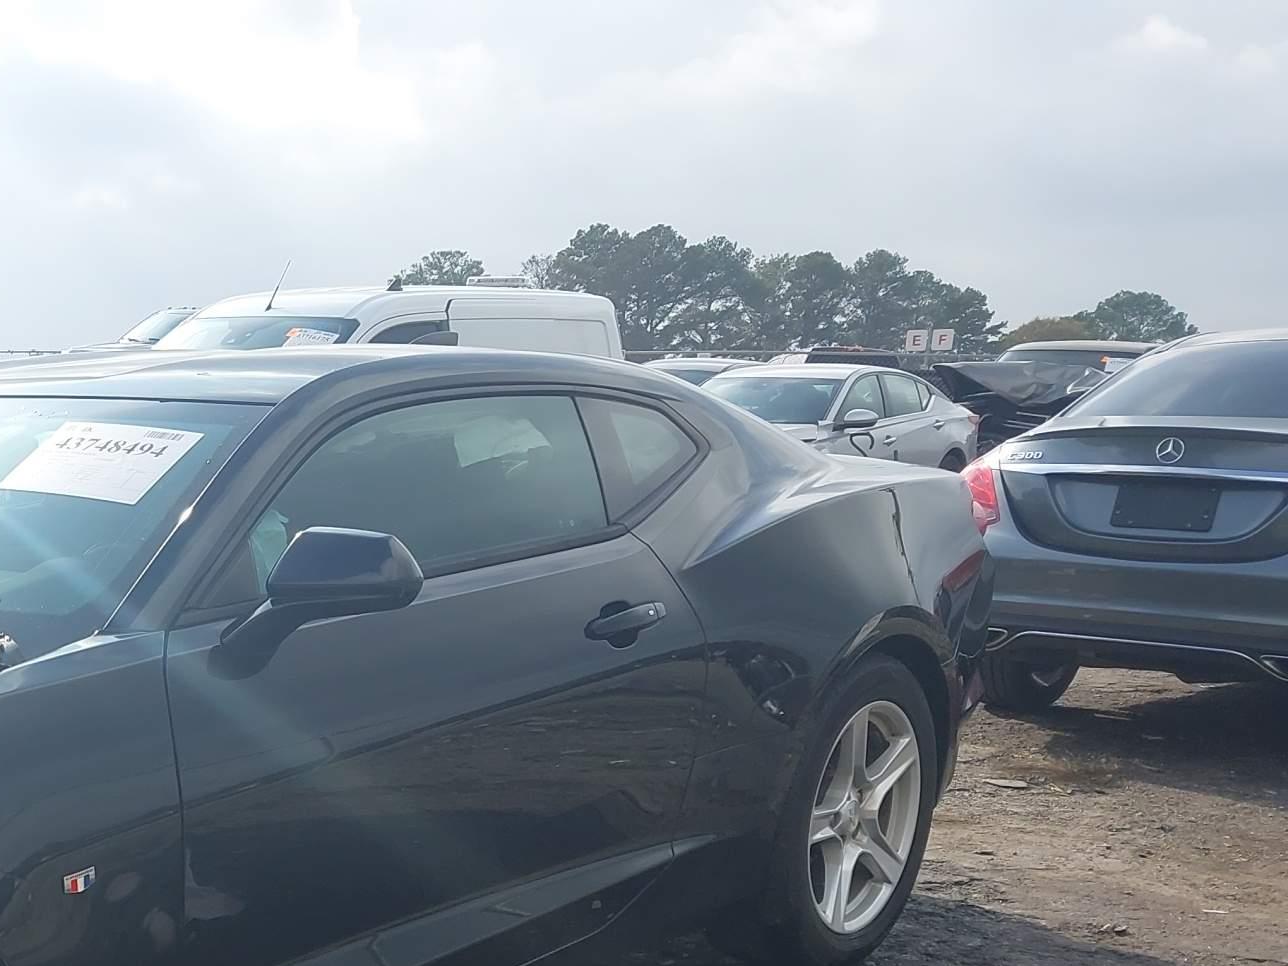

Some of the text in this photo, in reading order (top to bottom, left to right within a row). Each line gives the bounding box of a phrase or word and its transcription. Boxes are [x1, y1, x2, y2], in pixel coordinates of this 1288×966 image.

[912, 335, 921, 346] E
[938, 334, 948, 345] F
[55, 436, 169, 458] 43748494
[1008, 451, 1043, 461] C300
